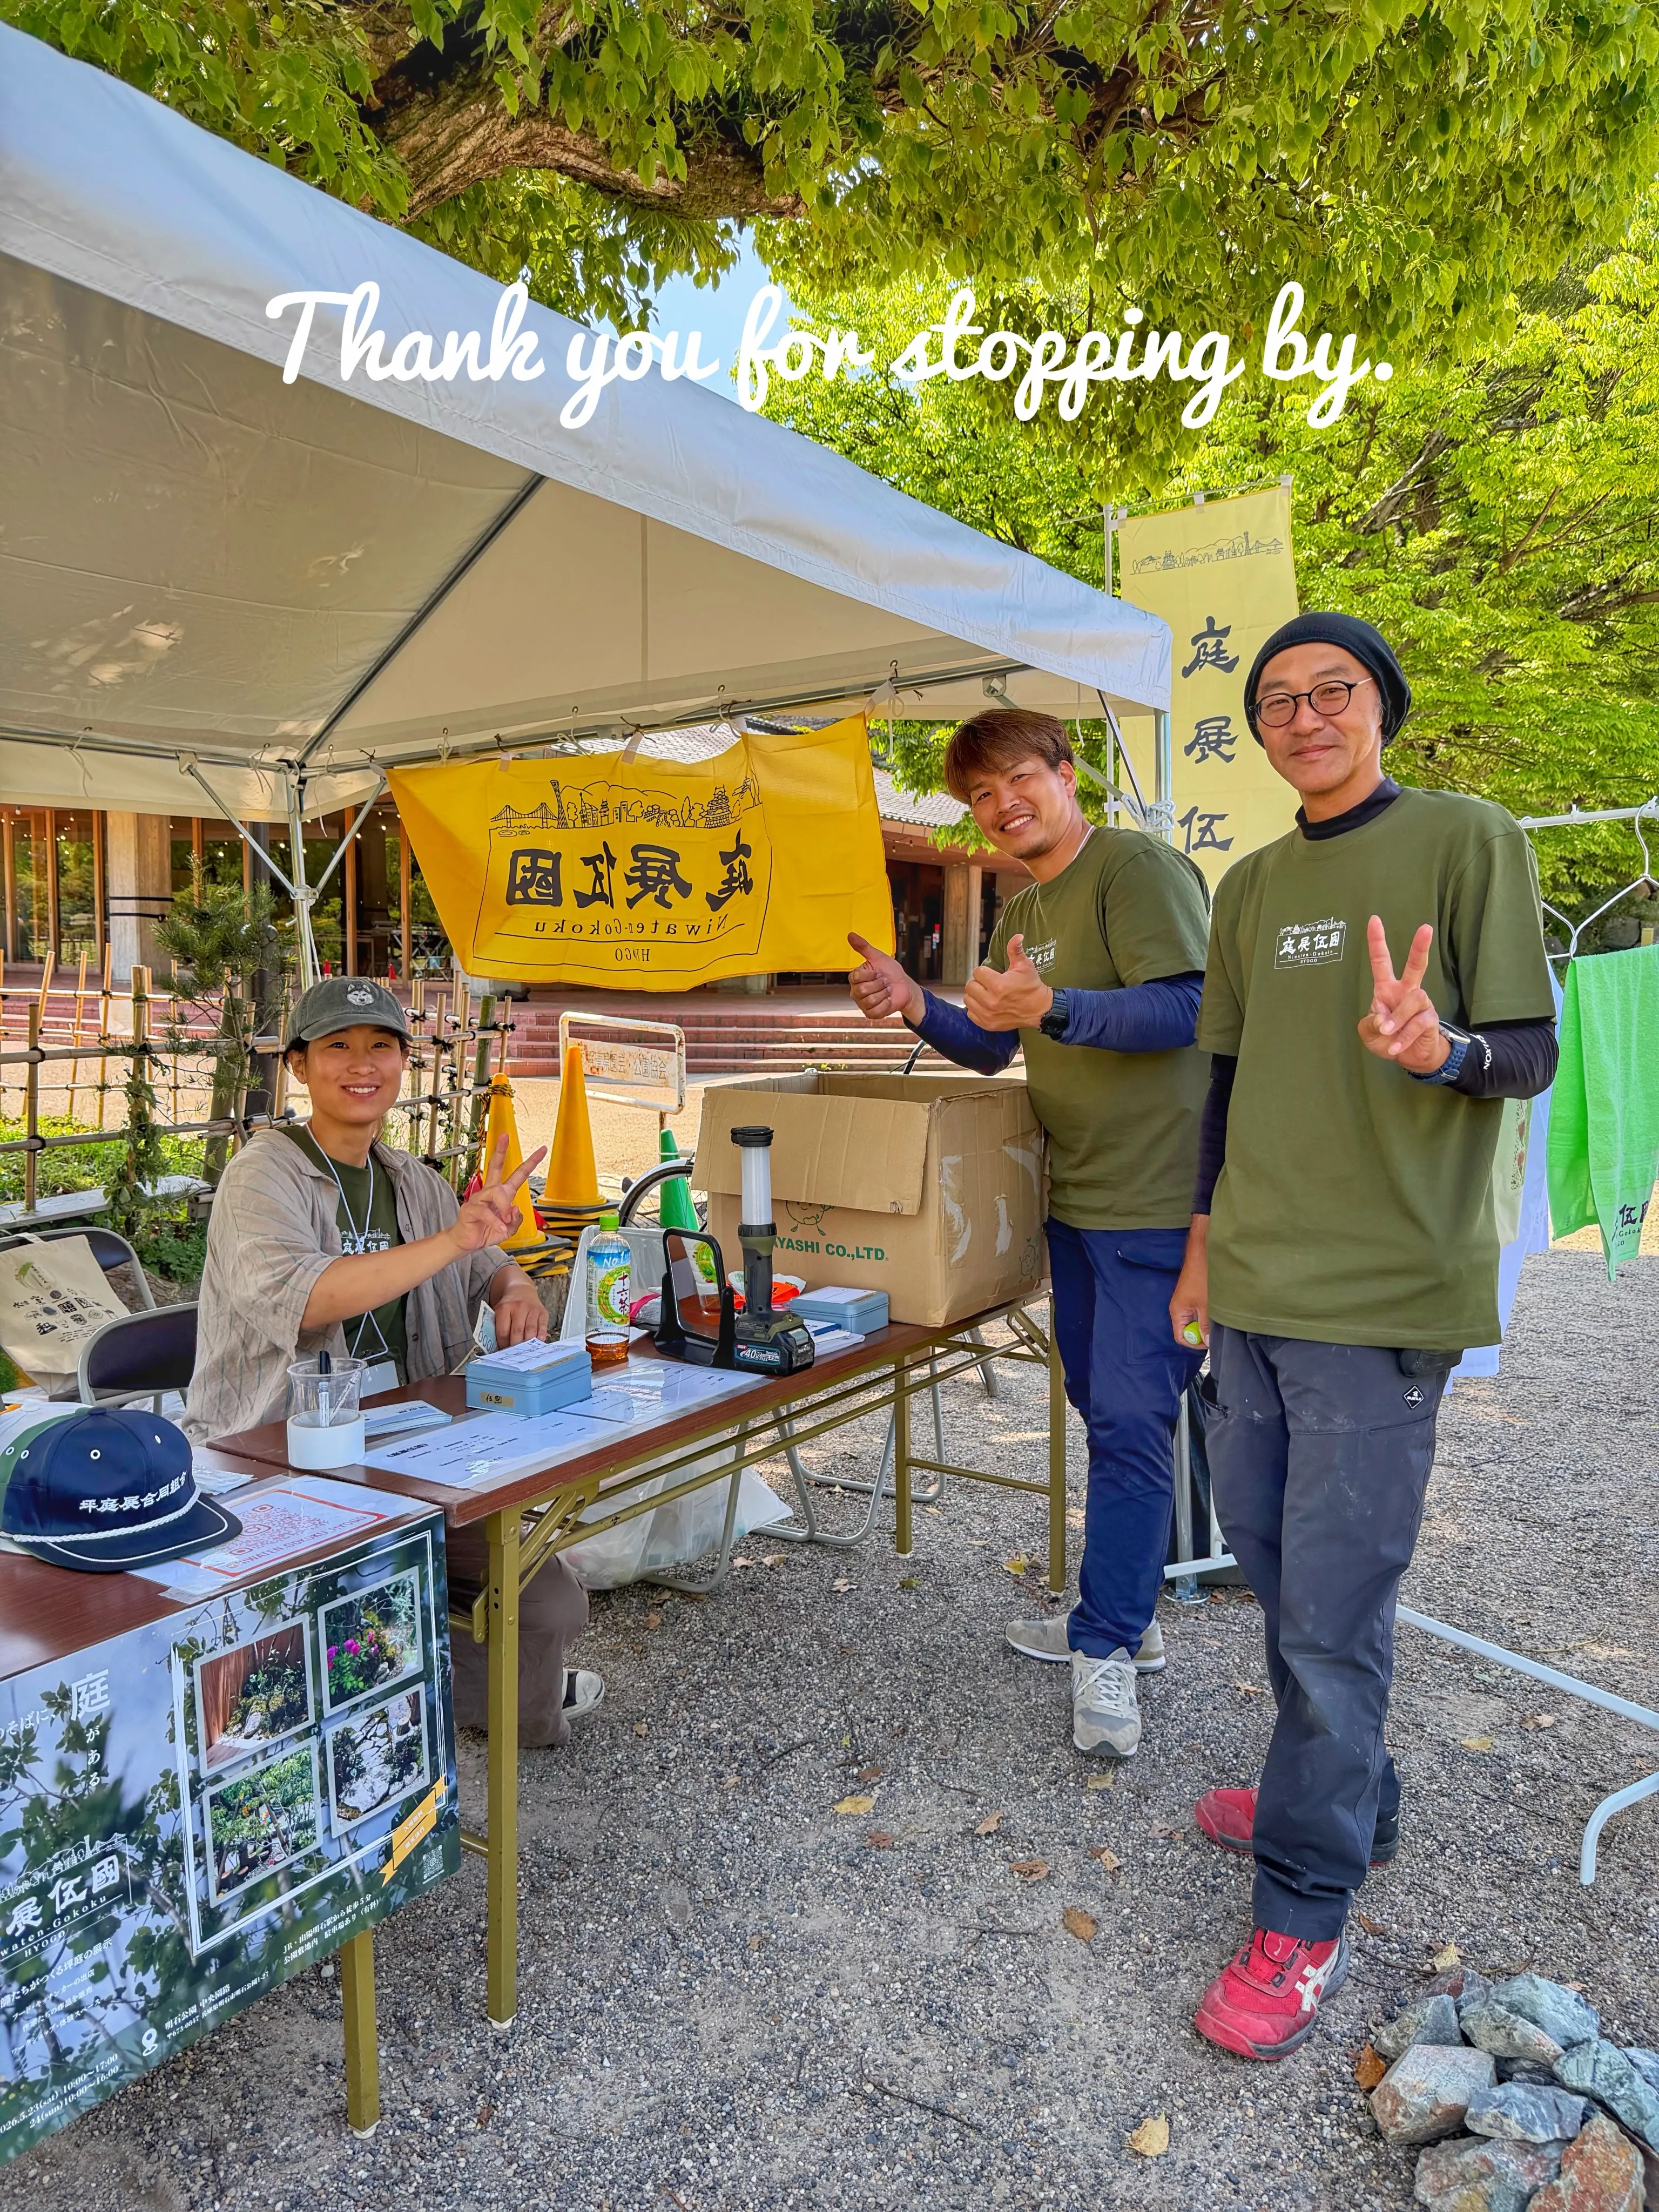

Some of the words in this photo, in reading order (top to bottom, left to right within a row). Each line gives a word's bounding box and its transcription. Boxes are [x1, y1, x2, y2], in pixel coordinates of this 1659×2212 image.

[79, 1470, 187, 1513] 坪庭展合同組合
[24, 1930, 66, 1958] HYOGO
